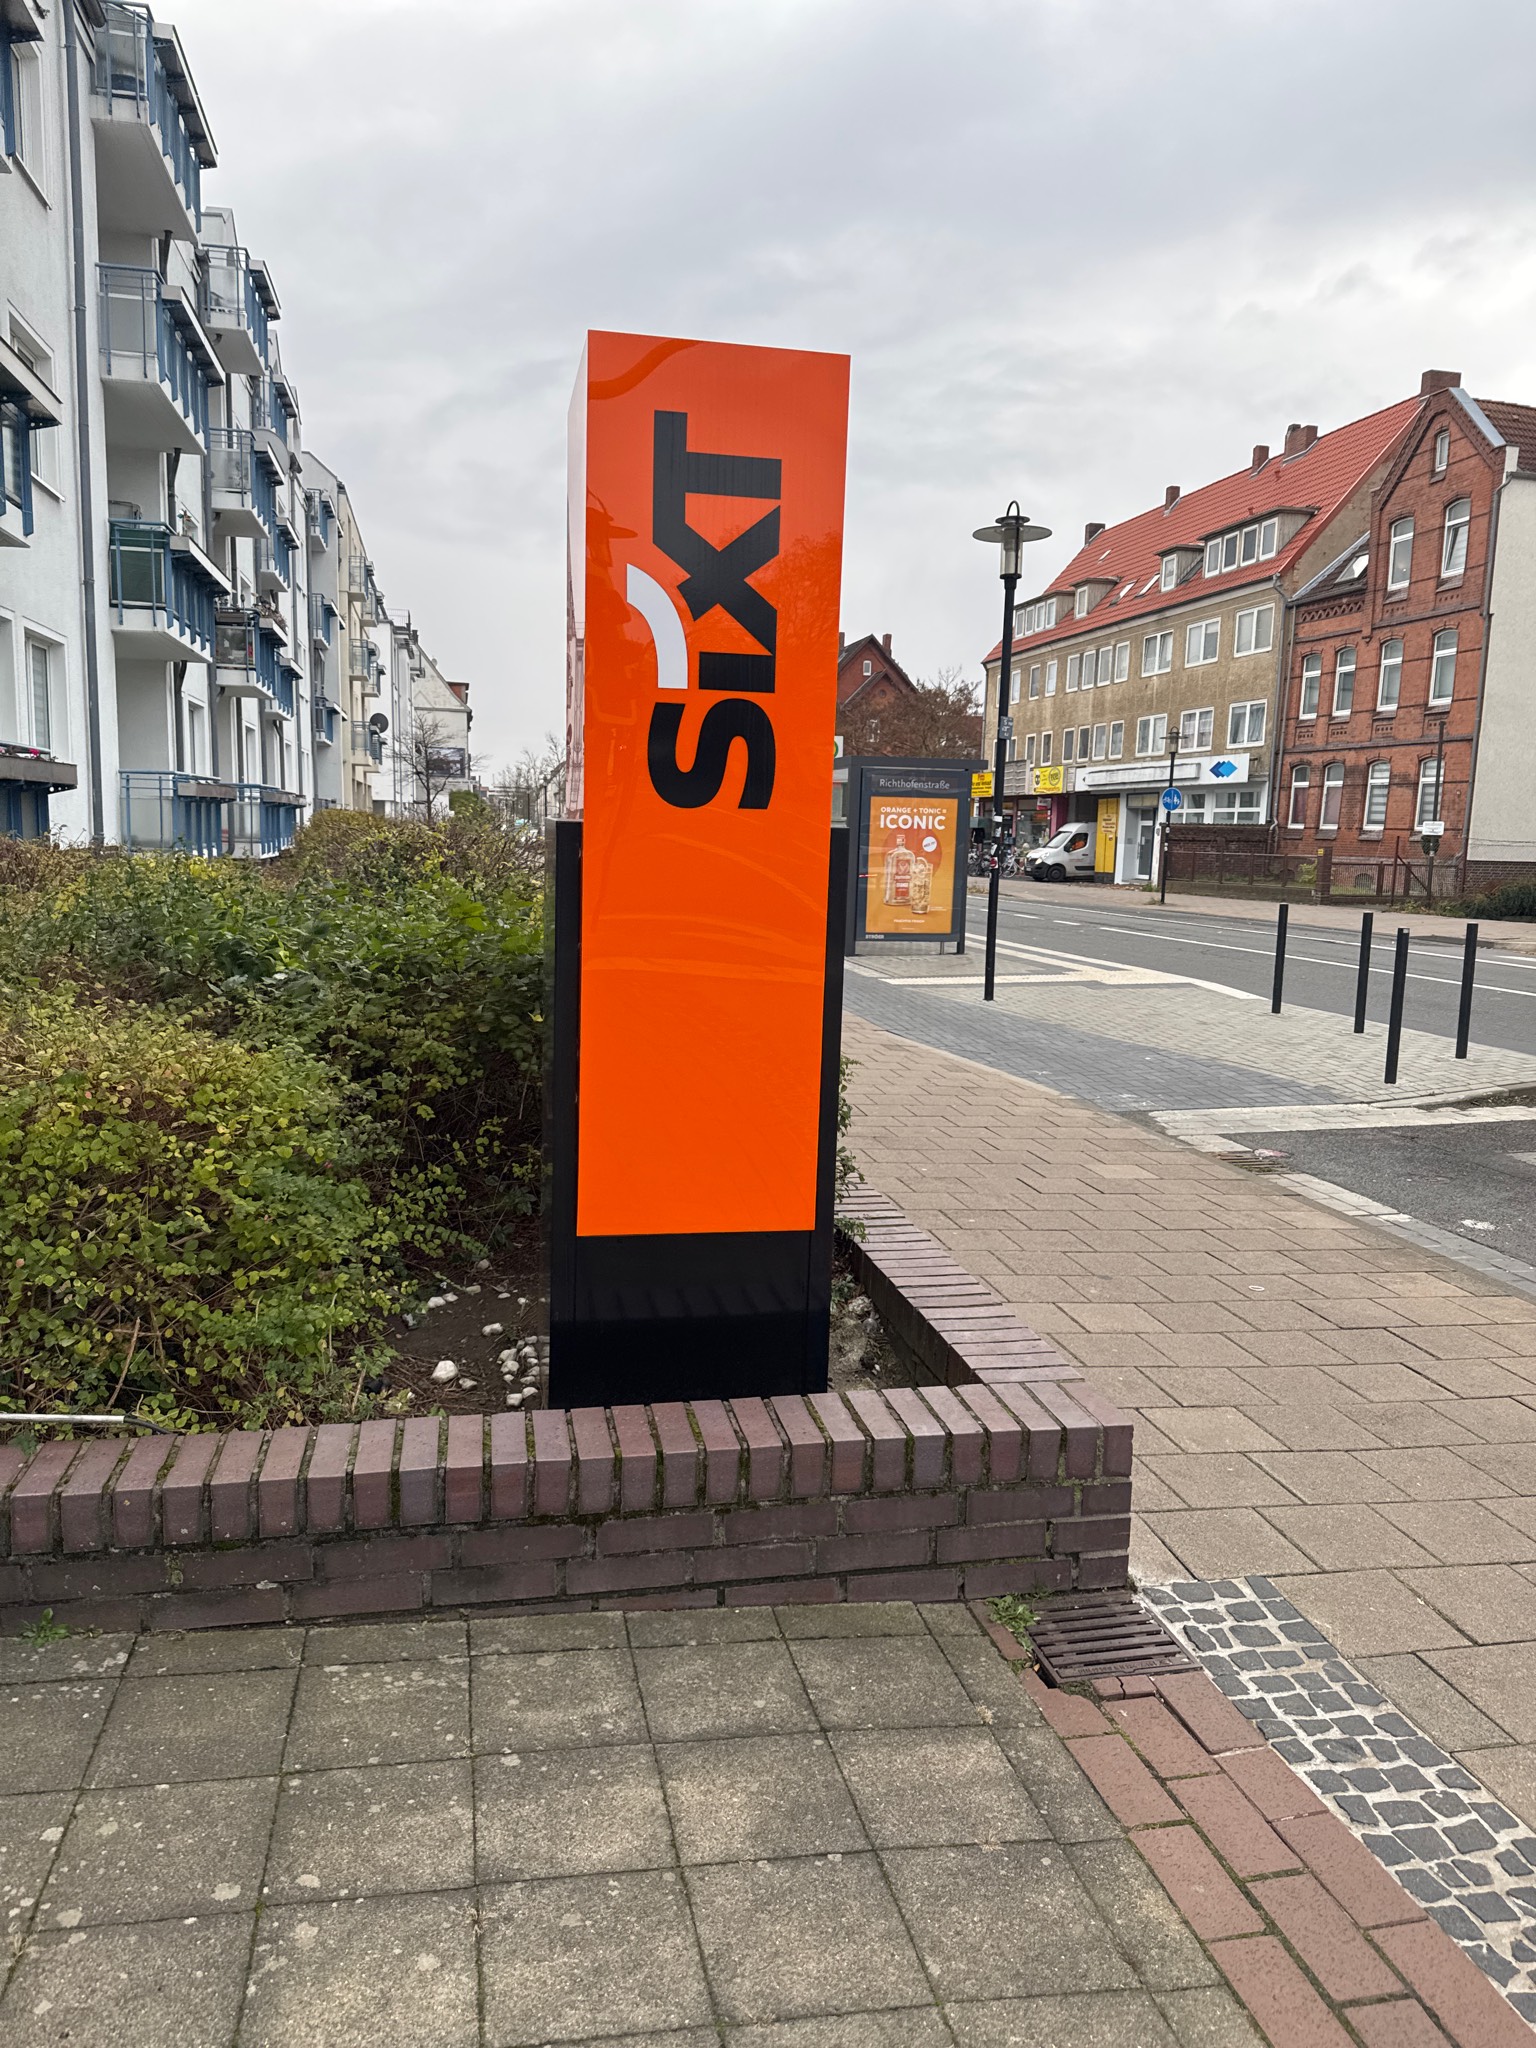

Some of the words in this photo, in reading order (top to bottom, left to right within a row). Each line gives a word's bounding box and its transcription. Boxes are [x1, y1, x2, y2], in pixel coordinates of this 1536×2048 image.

[627, 410, 782, 809] SIXT
[879, 778, 950, 790] Richthofenstraße
[880, 806, 912, 814] ORANGE
[880, 814, 946, 830] ICONIC
